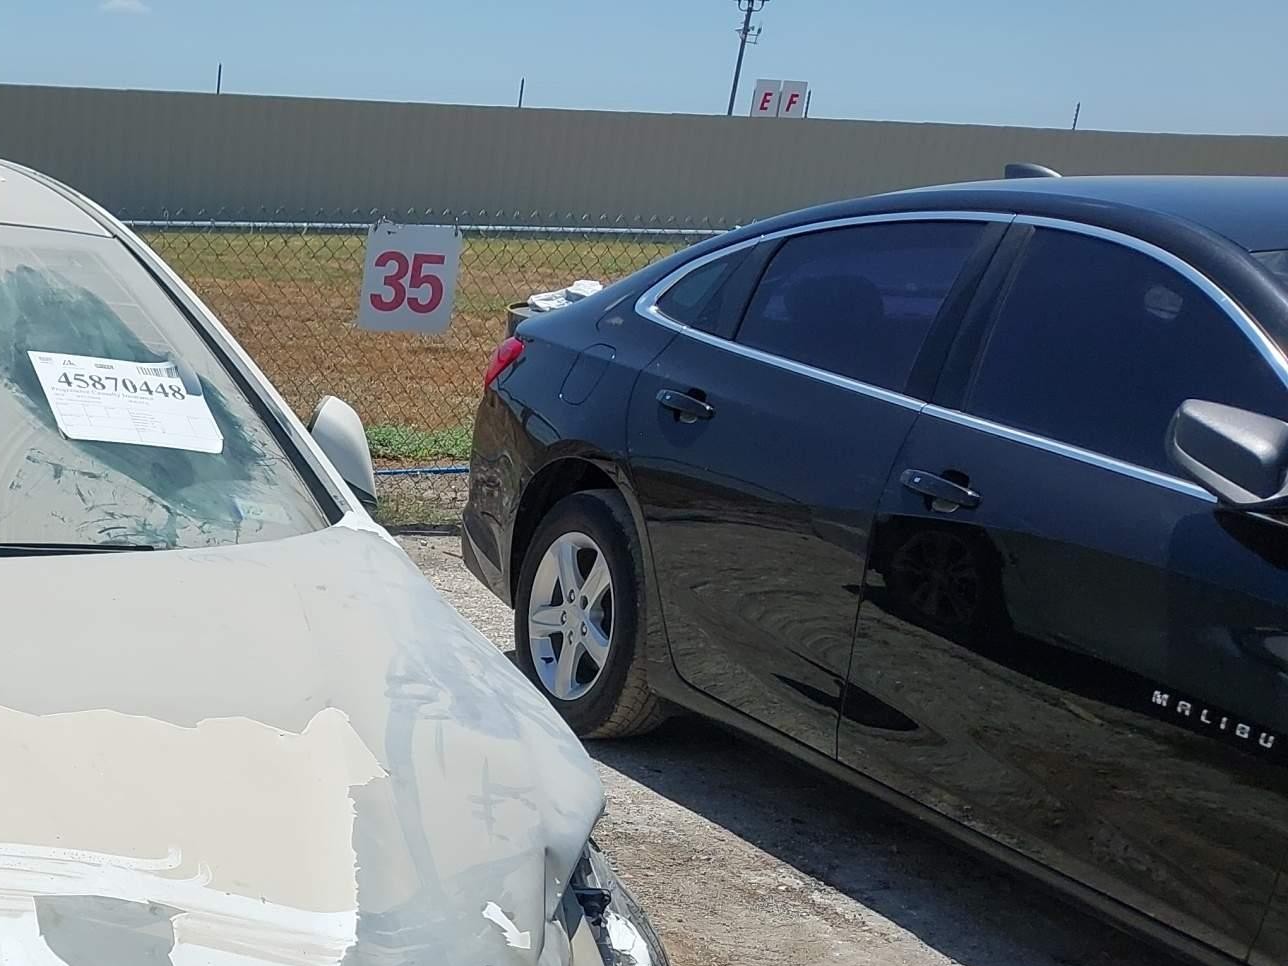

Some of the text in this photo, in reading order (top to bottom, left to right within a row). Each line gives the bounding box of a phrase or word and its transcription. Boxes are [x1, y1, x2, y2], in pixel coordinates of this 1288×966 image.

[759, 91, 773, 111] E
[785, 93, 800, 112] F
[369, 250, 446, 314] 35
[57, 371, 186, 401] 45870448
[1152, 690, 1275, 748] MALIBU
